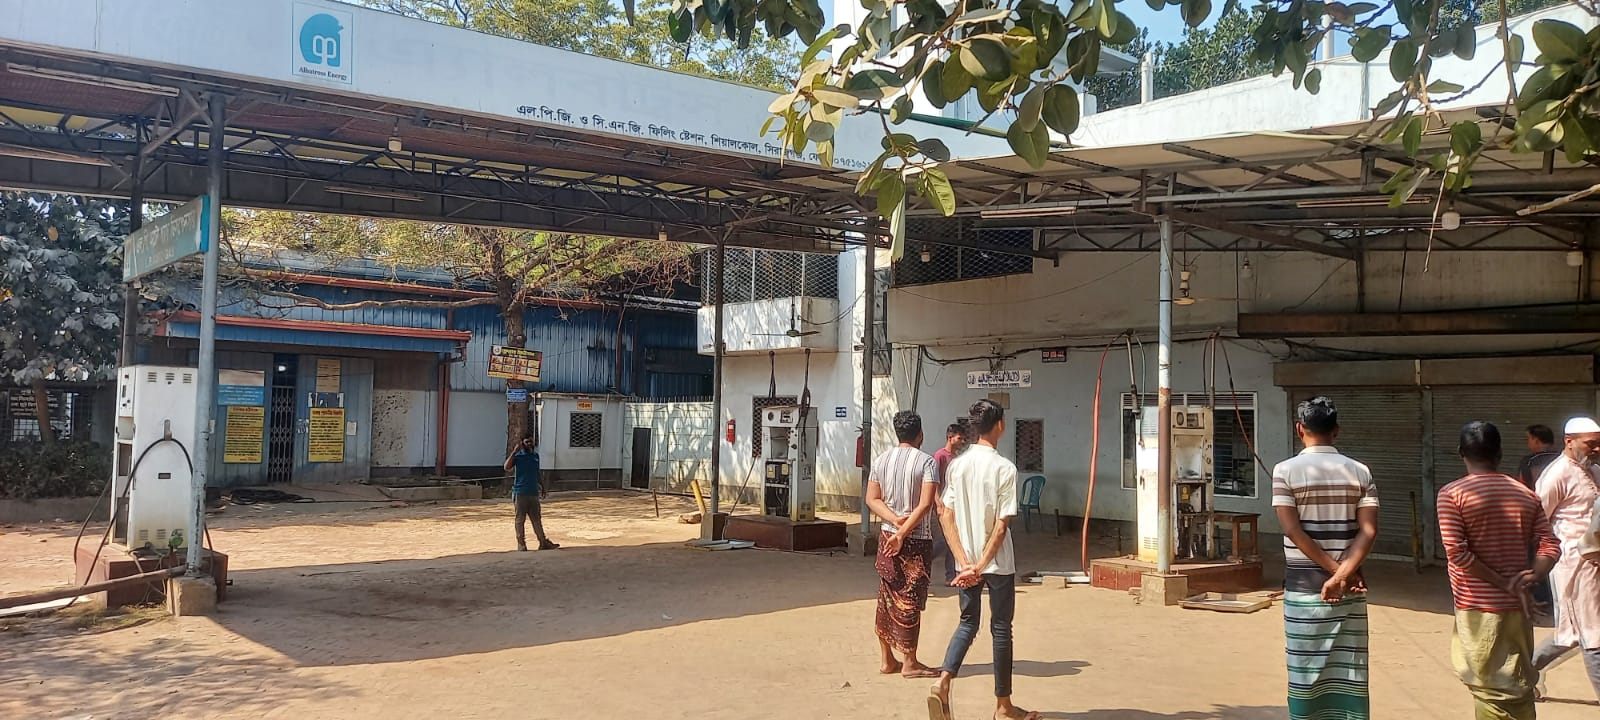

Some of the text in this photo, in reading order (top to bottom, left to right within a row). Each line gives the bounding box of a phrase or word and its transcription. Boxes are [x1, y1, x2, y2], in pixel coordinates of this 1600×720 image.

[299, 66, 347, 80] Albatross Energy
[516, 104, 575, 124] এল.পি.জি.
[579, 115, 589, 125] ও
[592, 114, 645, 136] সি.এন.জি.
[648, 124, 677, 140] ফিলিং
